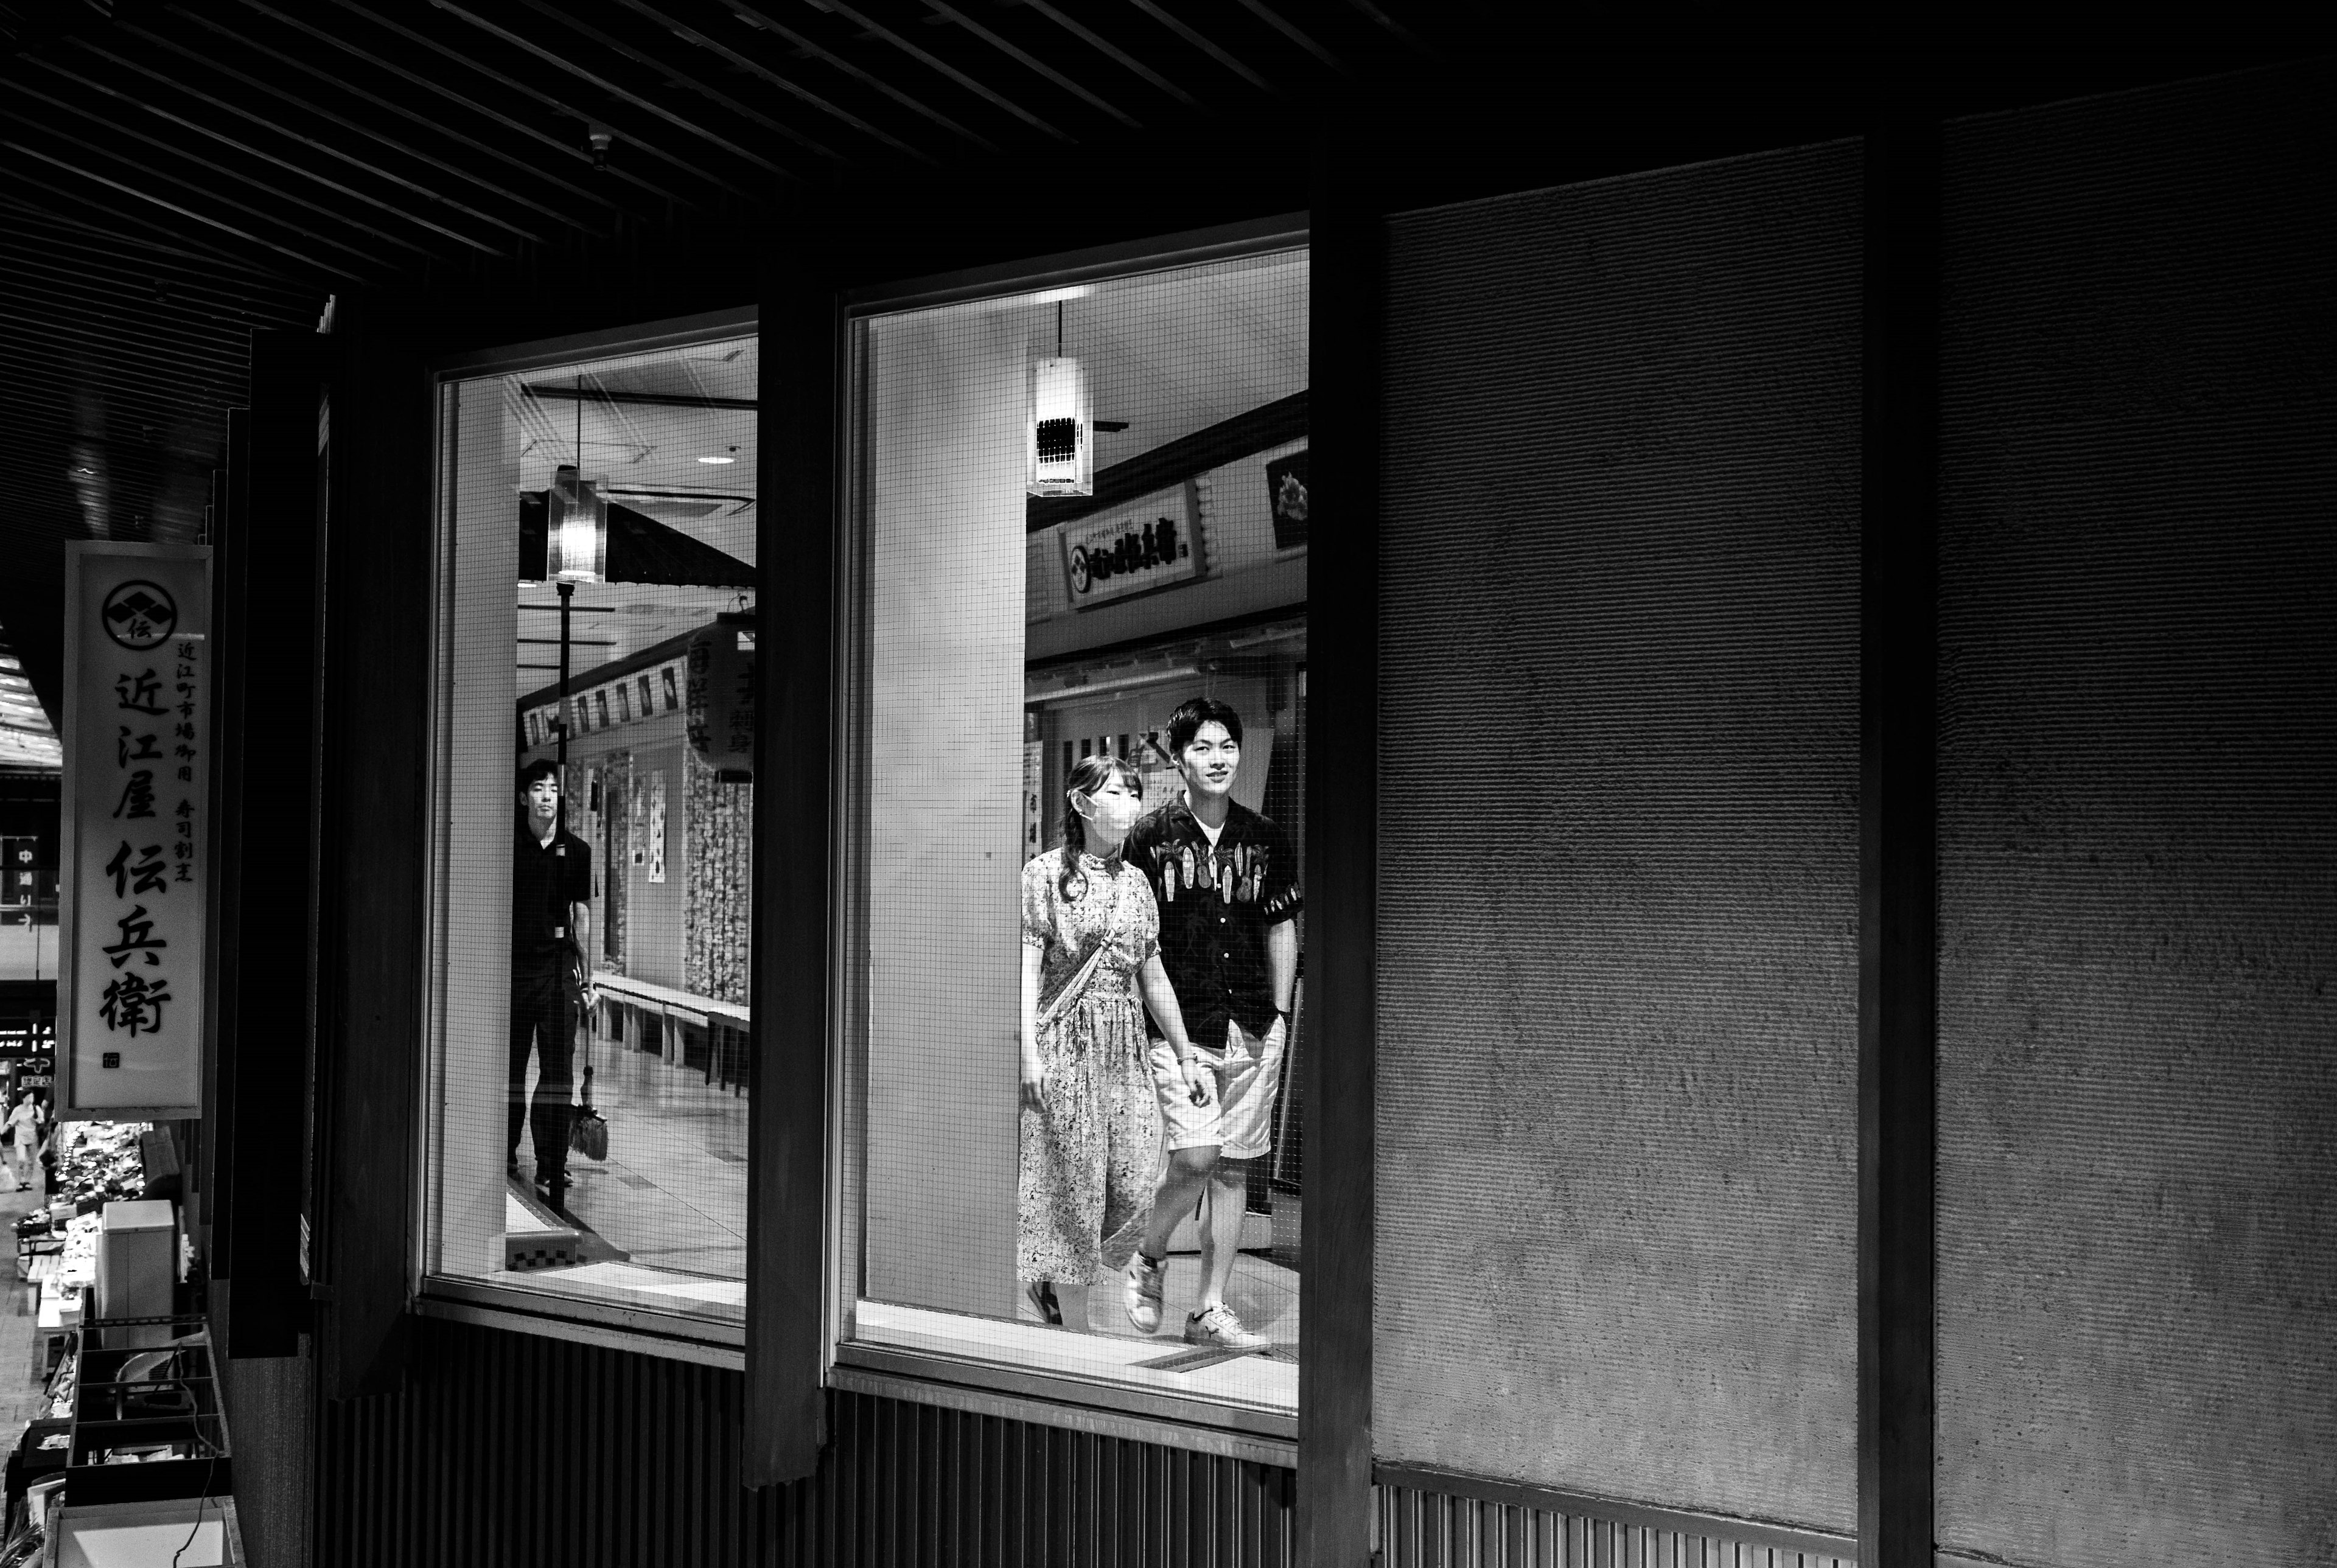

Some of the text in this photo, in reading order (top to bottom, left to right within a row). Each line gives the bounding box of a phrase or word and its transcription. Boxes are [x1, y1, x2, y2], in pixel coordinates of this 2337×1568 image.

[127, 618, 152, 638] 伝
[174, 642, 197, 782] 近江町市場御用
[99, 669, 171, 1037] 近江屋伝兵衛
